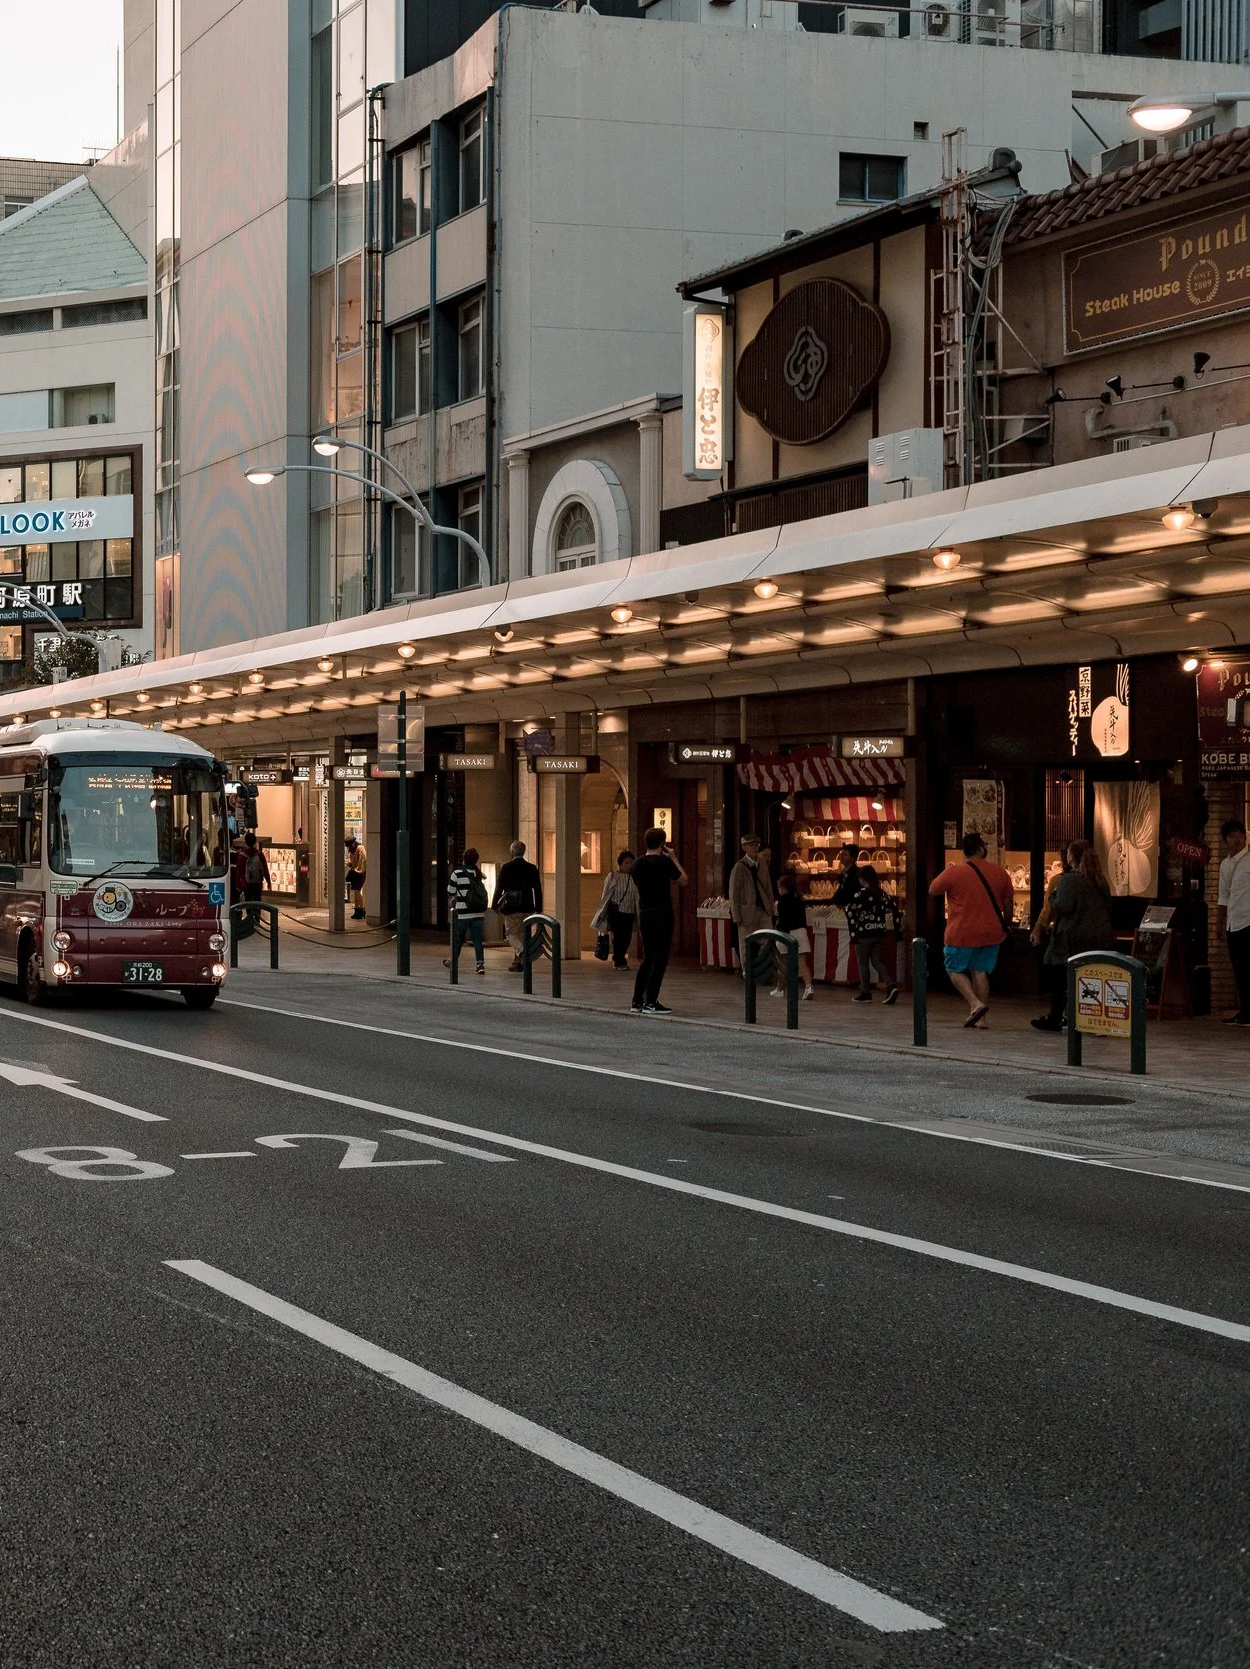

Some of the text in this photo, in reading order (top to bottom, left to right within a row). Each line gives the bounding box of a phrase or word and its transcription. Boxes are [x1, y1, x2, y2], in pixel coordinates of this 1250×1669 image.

[1159, 214, 1248, 272] Pound
[1193, 280, 1212, 291] 2009
[1085, 281, 1180, 317] Steak House
[698, 387, 720, 465] 伊と忠
[71, 519, 91, 528] メガネ
[1080, 668, 1090, 716] 京野菜
[455, 758, 486, 766] TASAKI
[545, 761, 578, 769] TASAKI
[1201, 753, 1236, 764] KOBE
[1177, 843, 1202, 857] OPEN
[156, 904, 187, 916] ループ
[130, 967, 163, 981] 31-28
